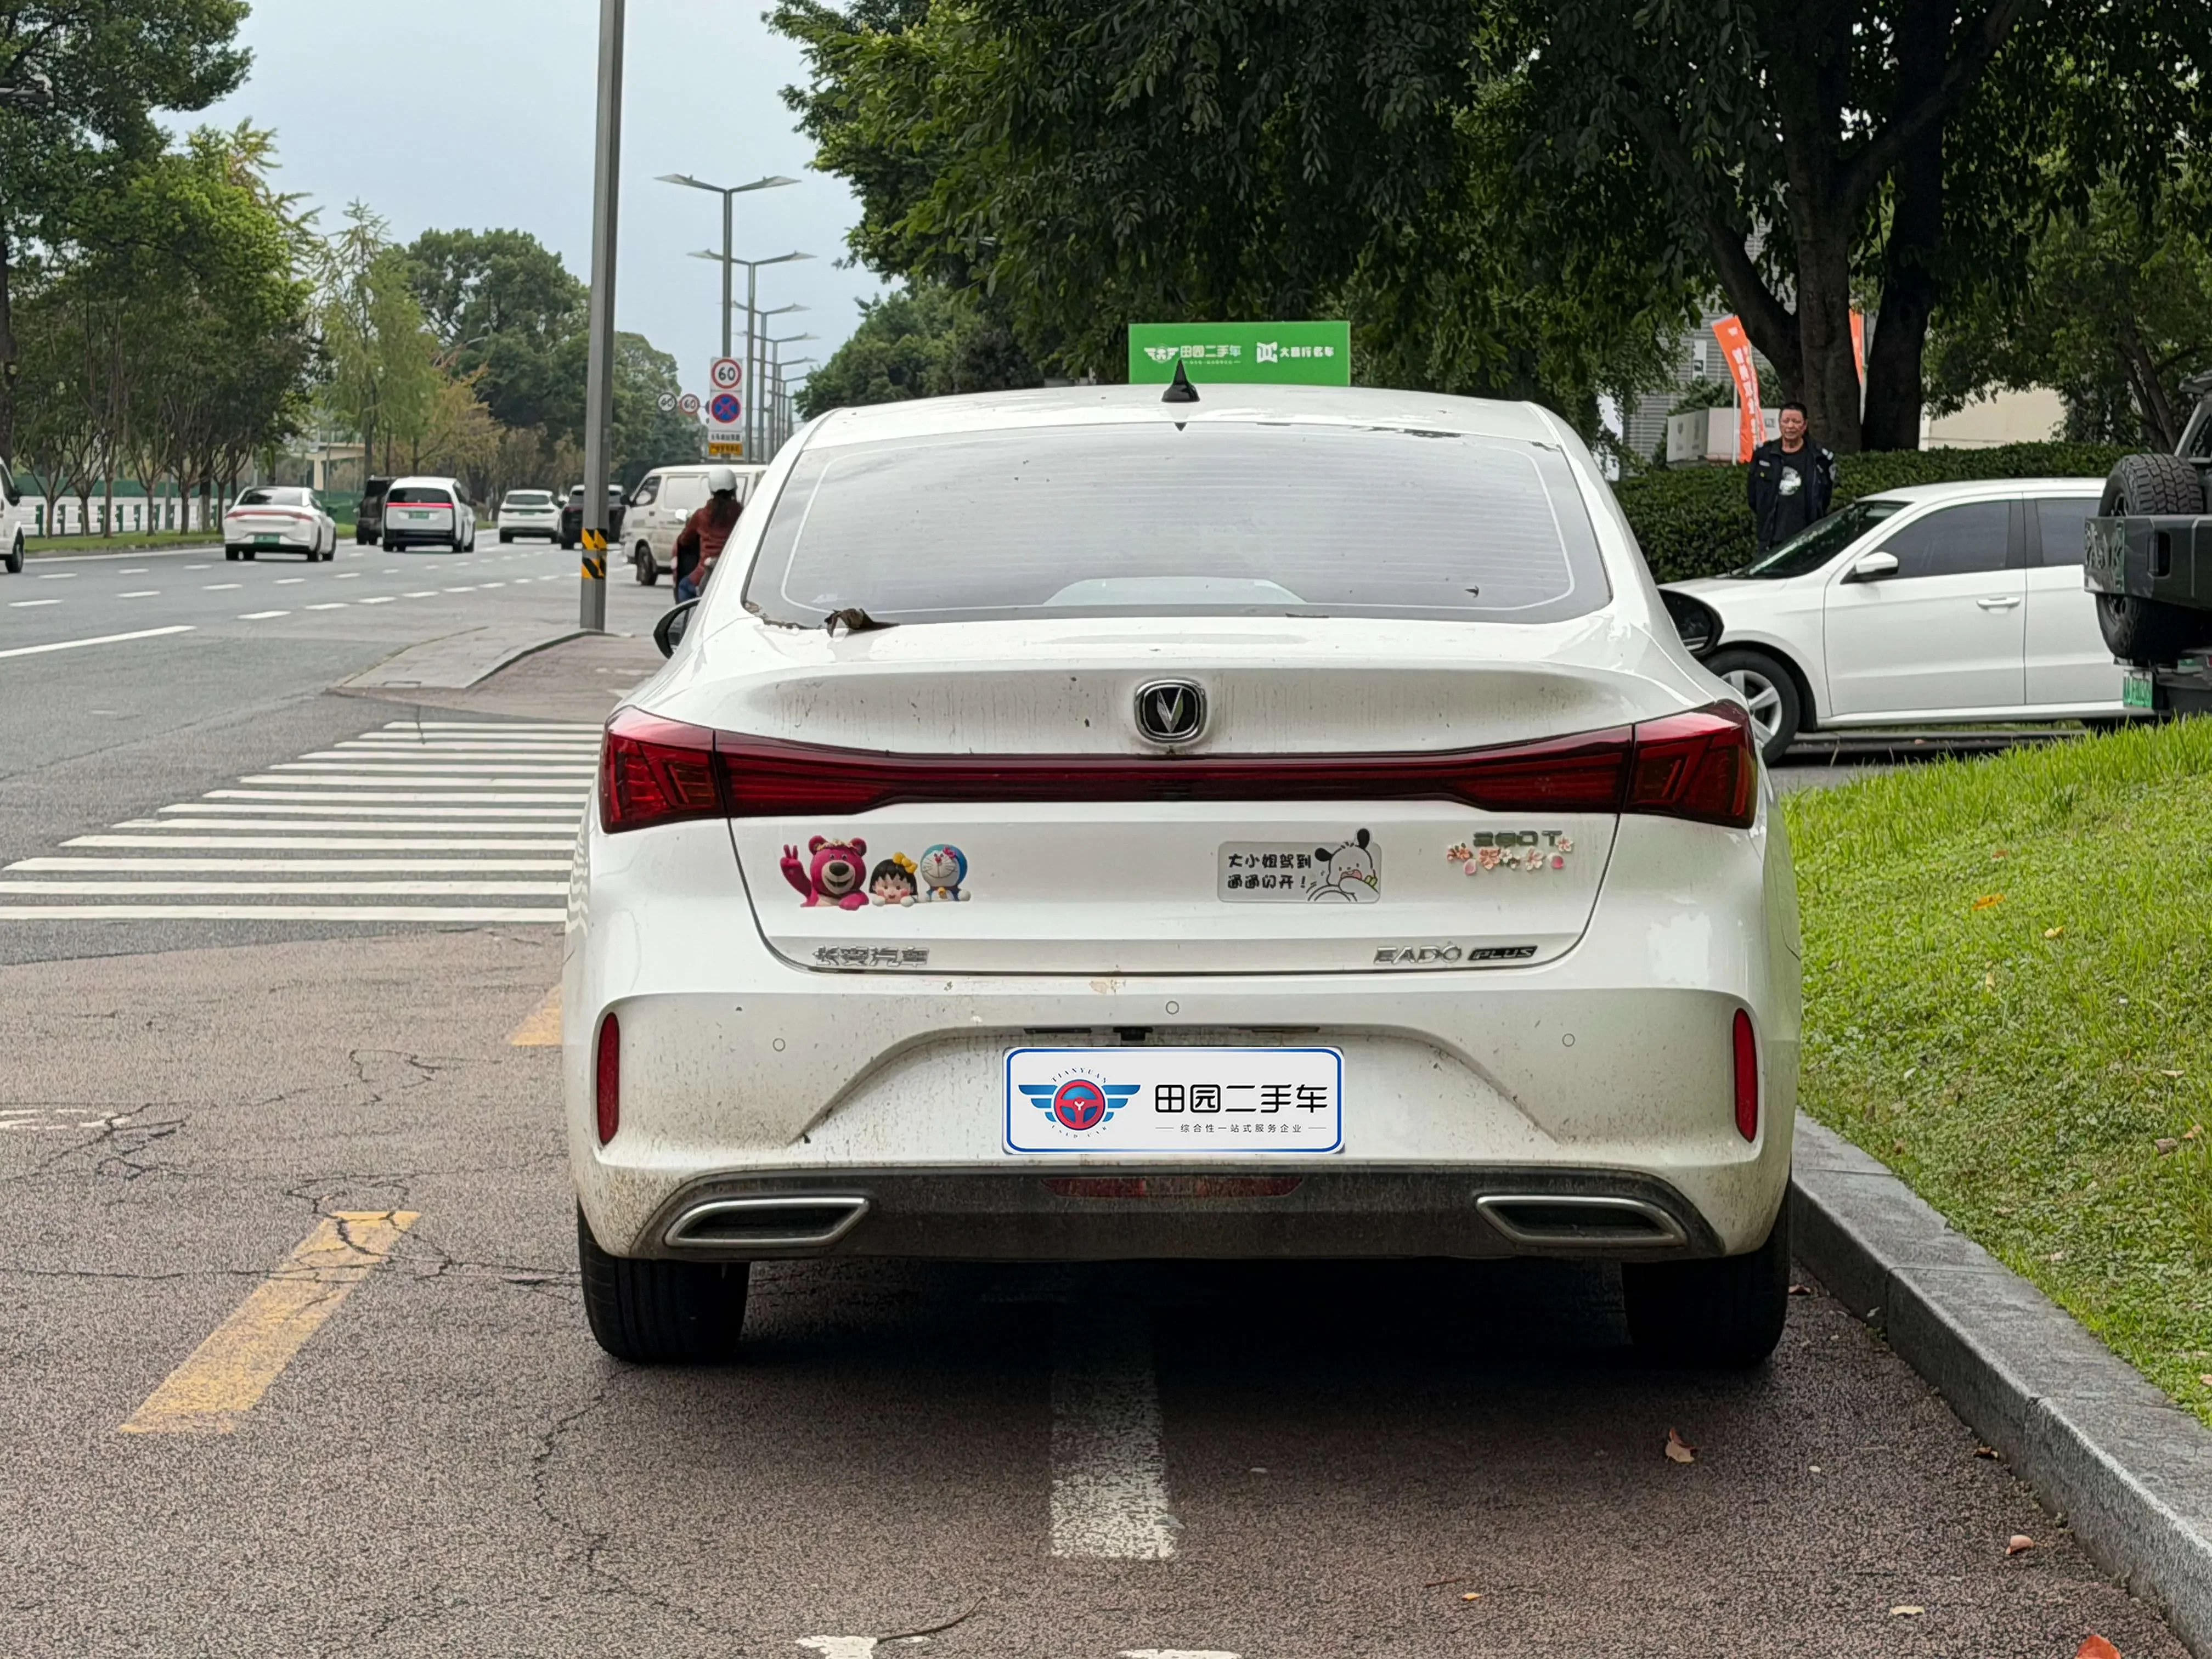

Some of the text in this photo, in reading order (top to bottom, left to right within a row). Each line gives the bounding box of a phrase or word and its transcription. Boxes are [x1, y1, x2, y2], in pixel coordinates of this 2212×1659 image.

[718, 367, 736, 381] 60
[1228, 854, 1311, 868] 大小姐驾到
[812, 945, 929, 967] 长安汽车
[1374, 945, 1536, 964] EADO PLUS
